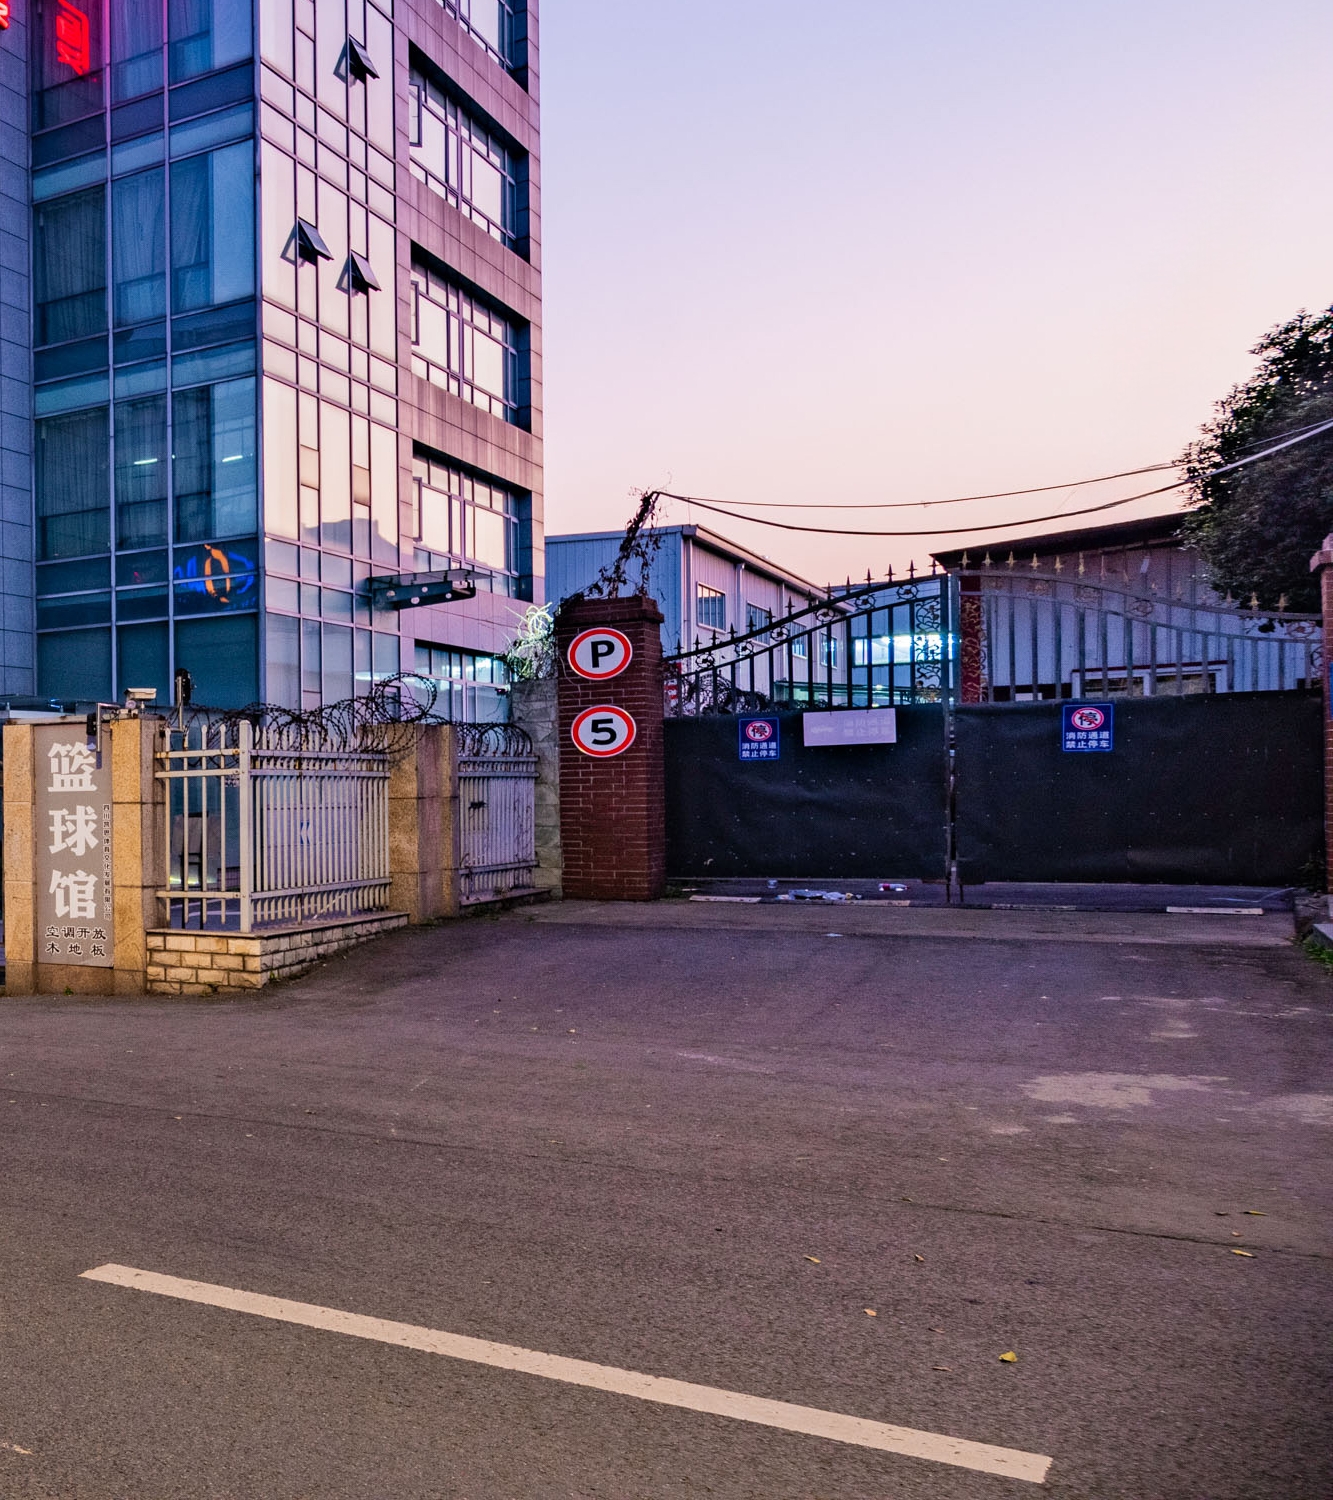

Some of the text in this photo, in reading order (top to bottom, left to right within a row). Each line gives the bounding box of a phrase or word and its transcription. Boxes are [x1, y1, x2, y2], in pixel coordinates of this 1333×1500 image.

[590, 640, 615, 669] P
[591, 718, 617, 745] 5
[1065, 731, 1110, 740] 消防通道
[741, 742, 777, 750] 消防通道
[1065, 740, 1110, 749] 禁止停车
[741, 750, 777, 758] 禁止停车
[47, 741, 99, 920] 篮球馆
[45, 925, 107, 941] 空调开放
[45, 941, 106, 958] 木地板
